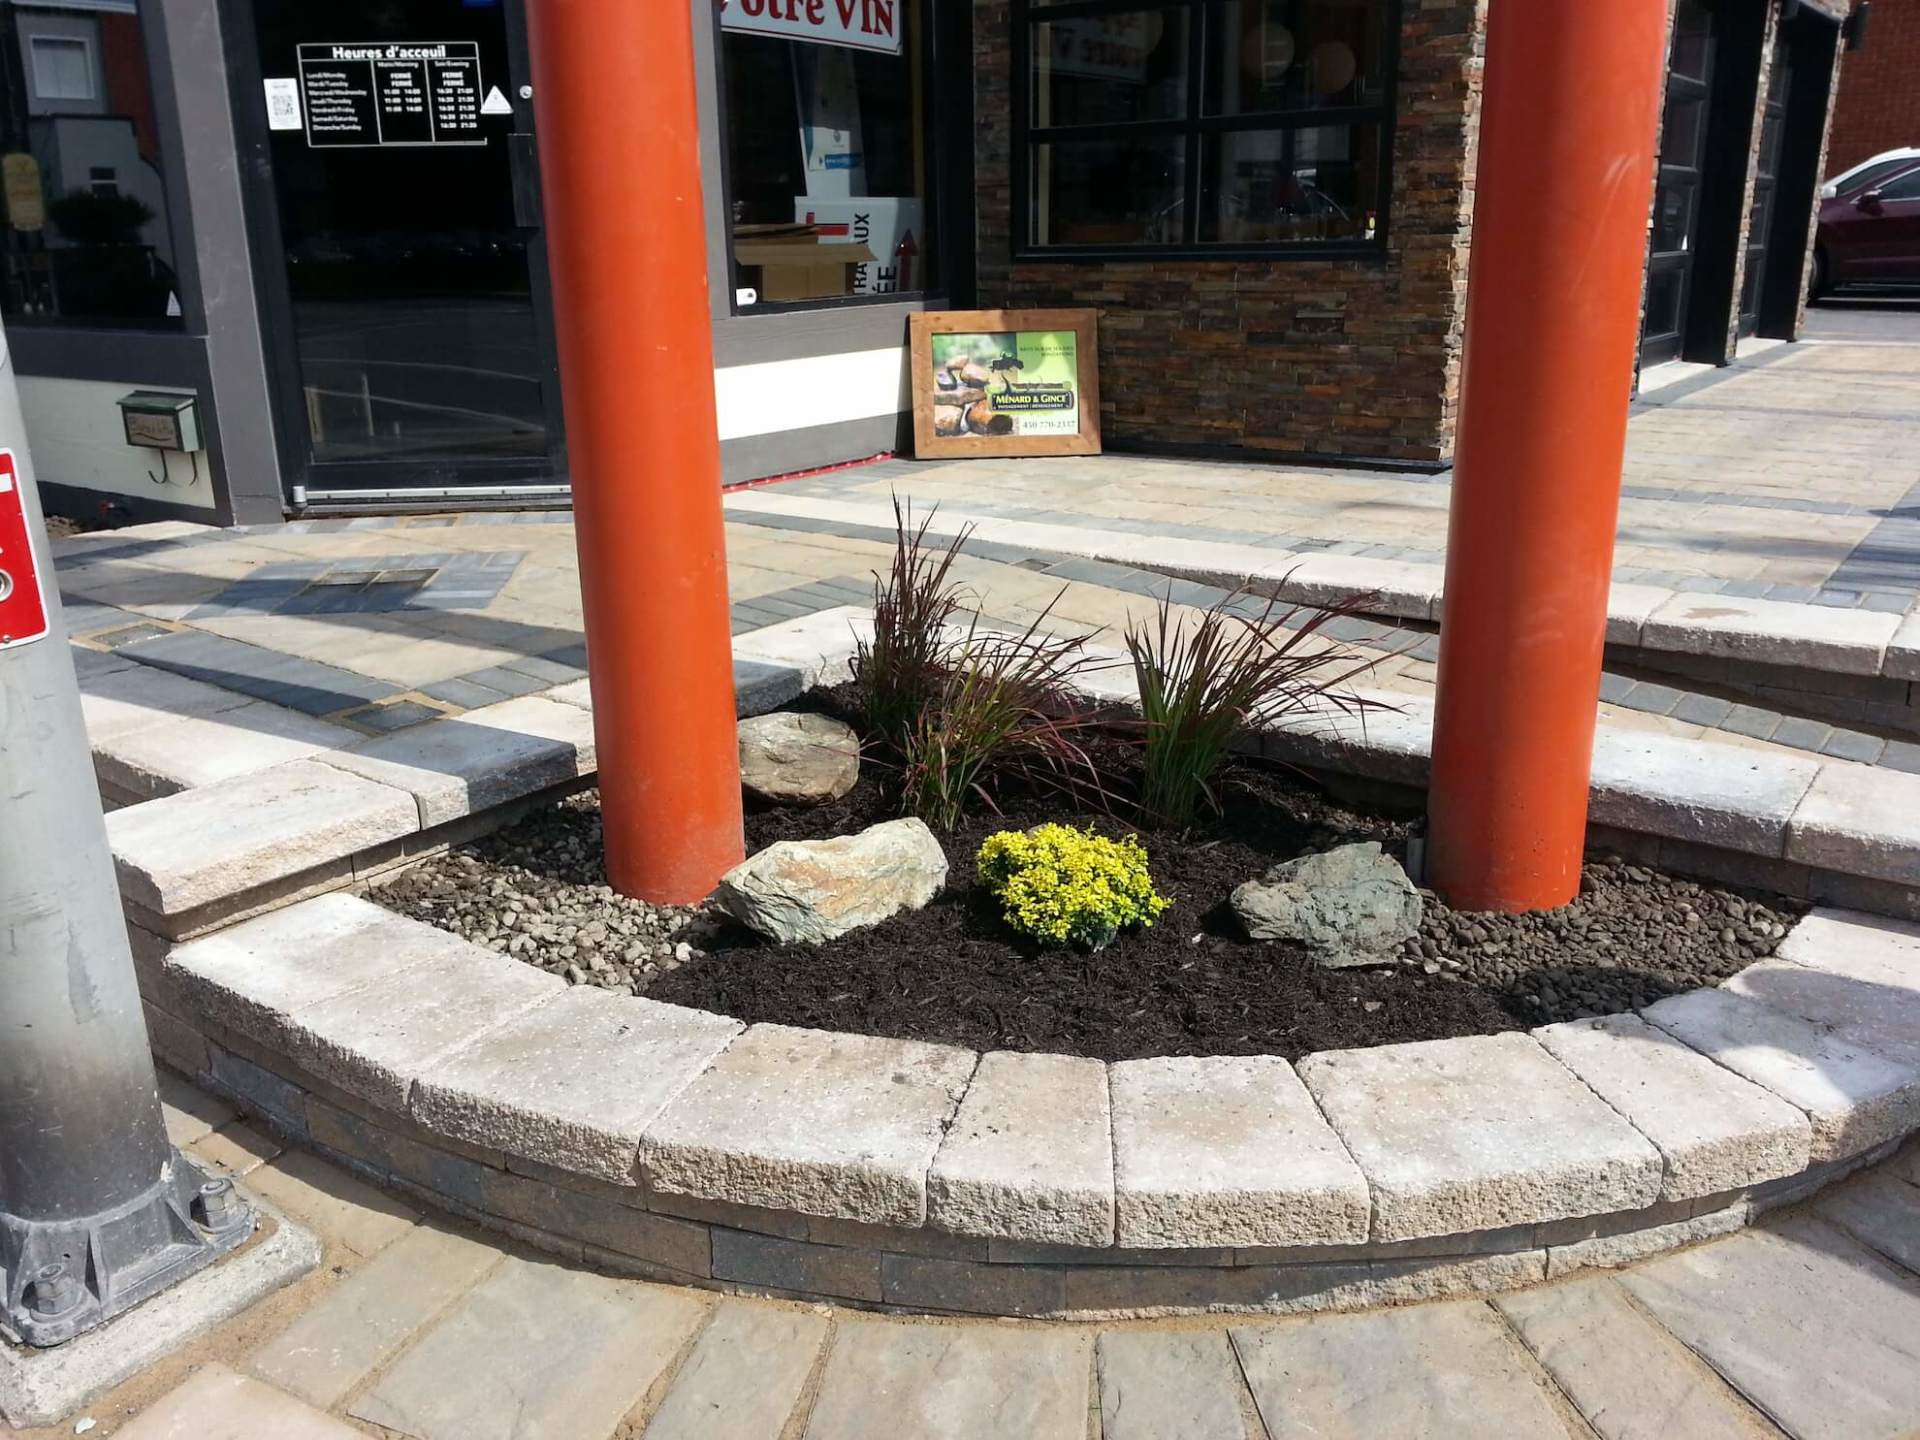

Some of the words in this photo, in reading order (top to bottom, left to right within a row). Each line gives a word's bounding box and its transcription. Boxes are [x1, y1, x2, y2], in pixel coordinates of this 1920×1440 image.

[720, 0, 825, 25] otre
[834, 0, 893, 37] VIN
[332, 46, 383, 59] Heures
[385, 45, 446, 58] d'acceuil
[996, 394, 1031, 403] MÉNARD
